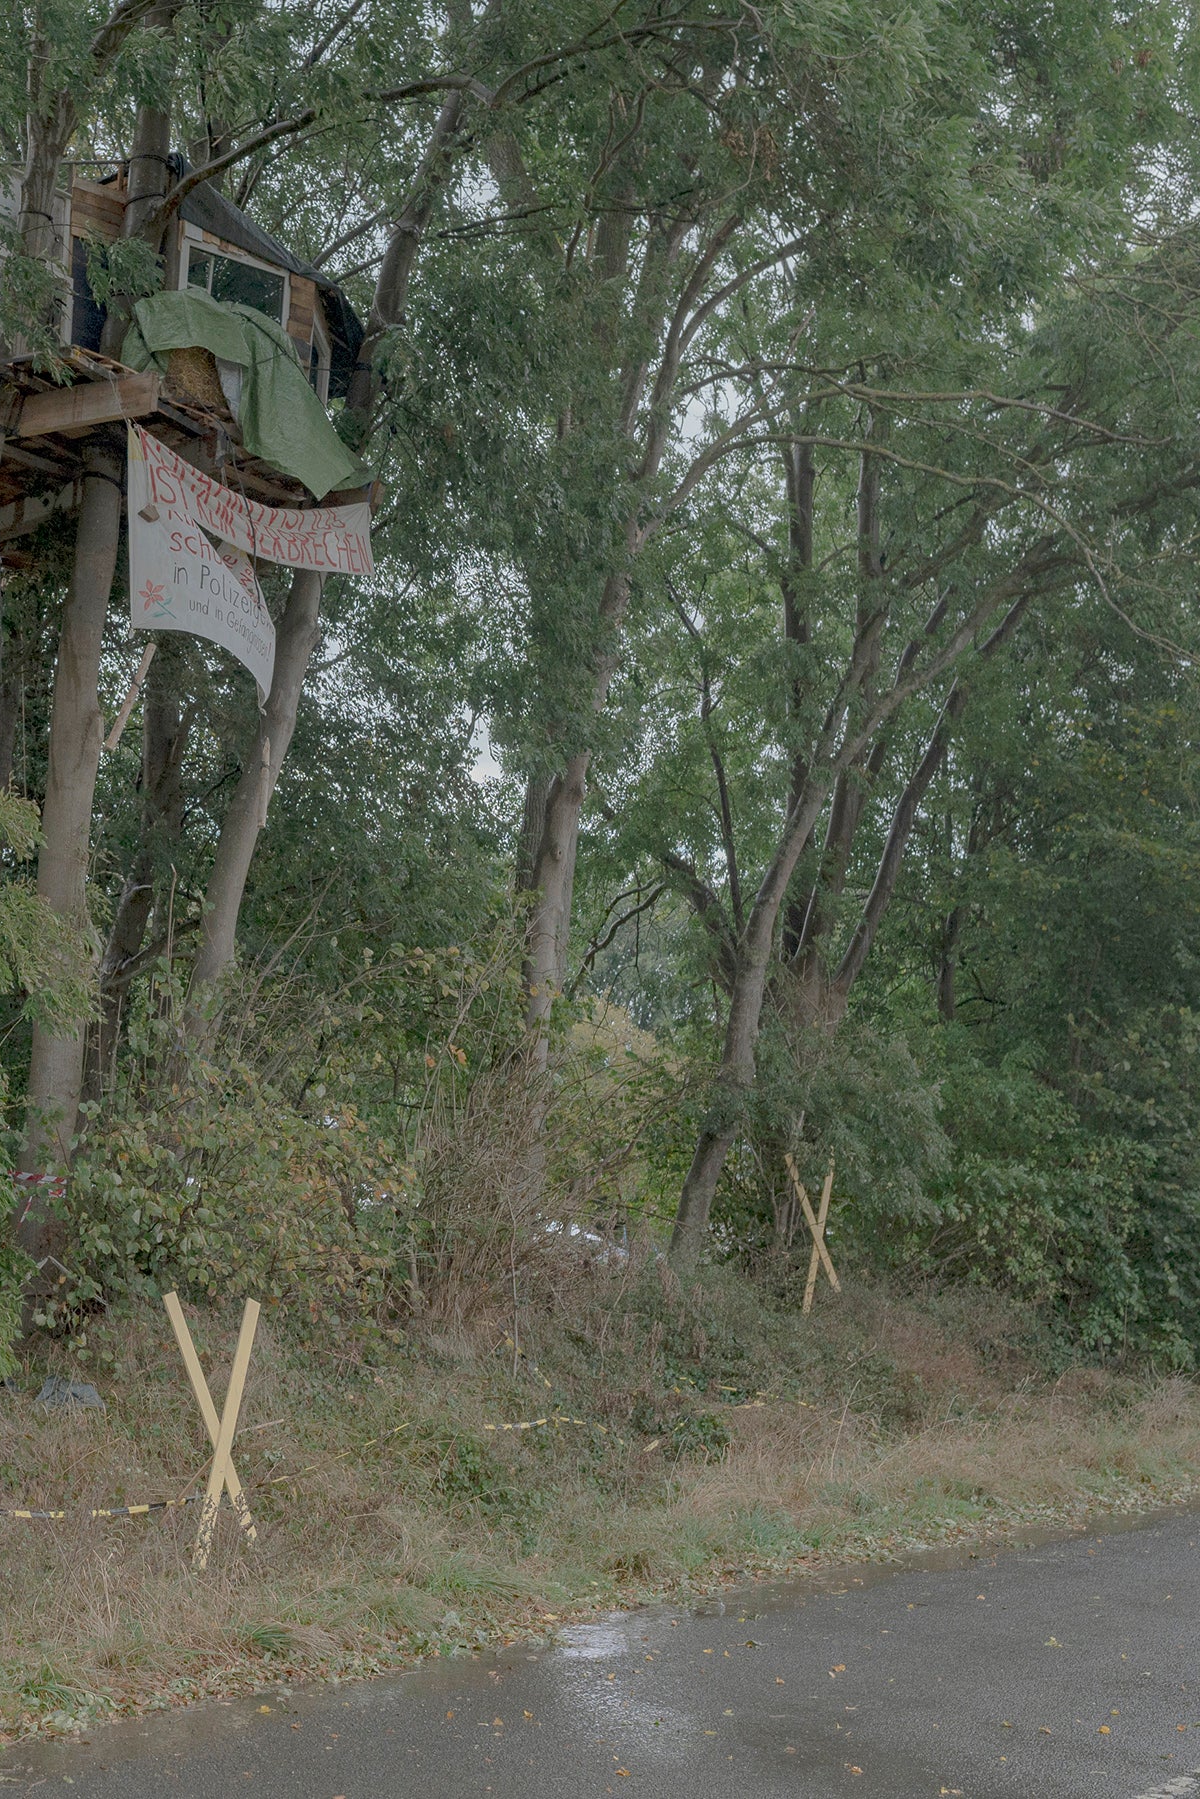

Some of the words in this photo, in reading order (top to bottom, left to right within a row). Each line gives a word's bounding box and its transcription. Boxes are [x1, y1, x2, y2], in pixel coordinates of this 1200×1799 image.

[246, 521, 372, 574] VERBRECHEN
[173, 562, 189, 586] in
[189, 598, 209, 616] und
[215, 605, 224, 622] in
